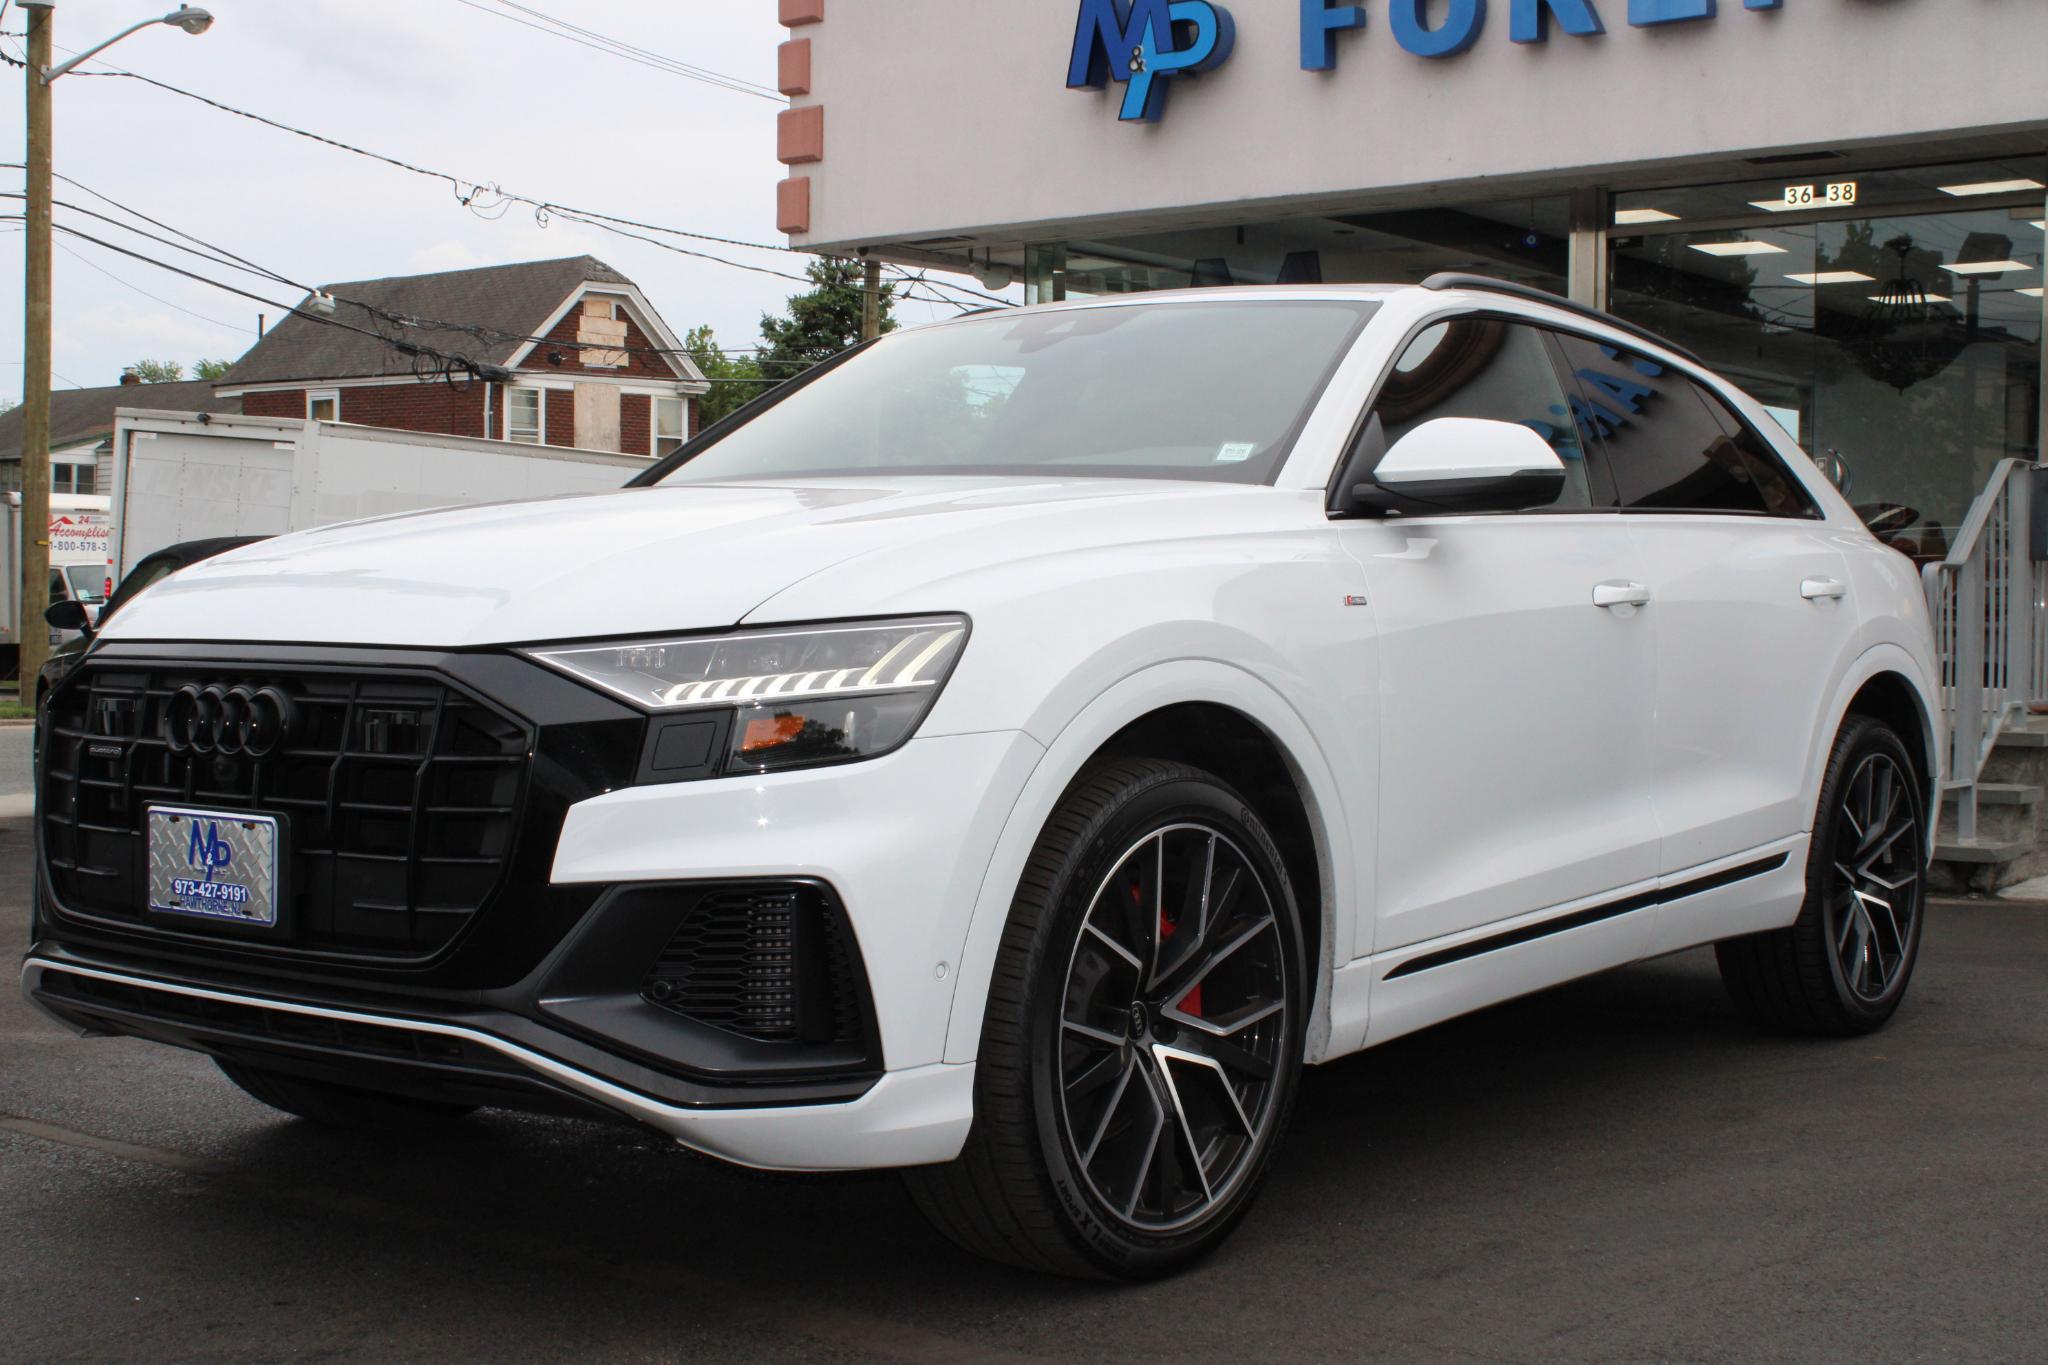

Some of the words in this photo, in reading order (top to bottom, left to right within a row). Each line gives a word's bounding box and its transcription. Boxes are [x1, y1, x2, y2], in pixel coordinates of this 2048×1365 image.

[1787, 187, 1812, 205] 36
[1829, 184, 1853, 202] 38
[174, 879, 247, 902] 973-427-9191
